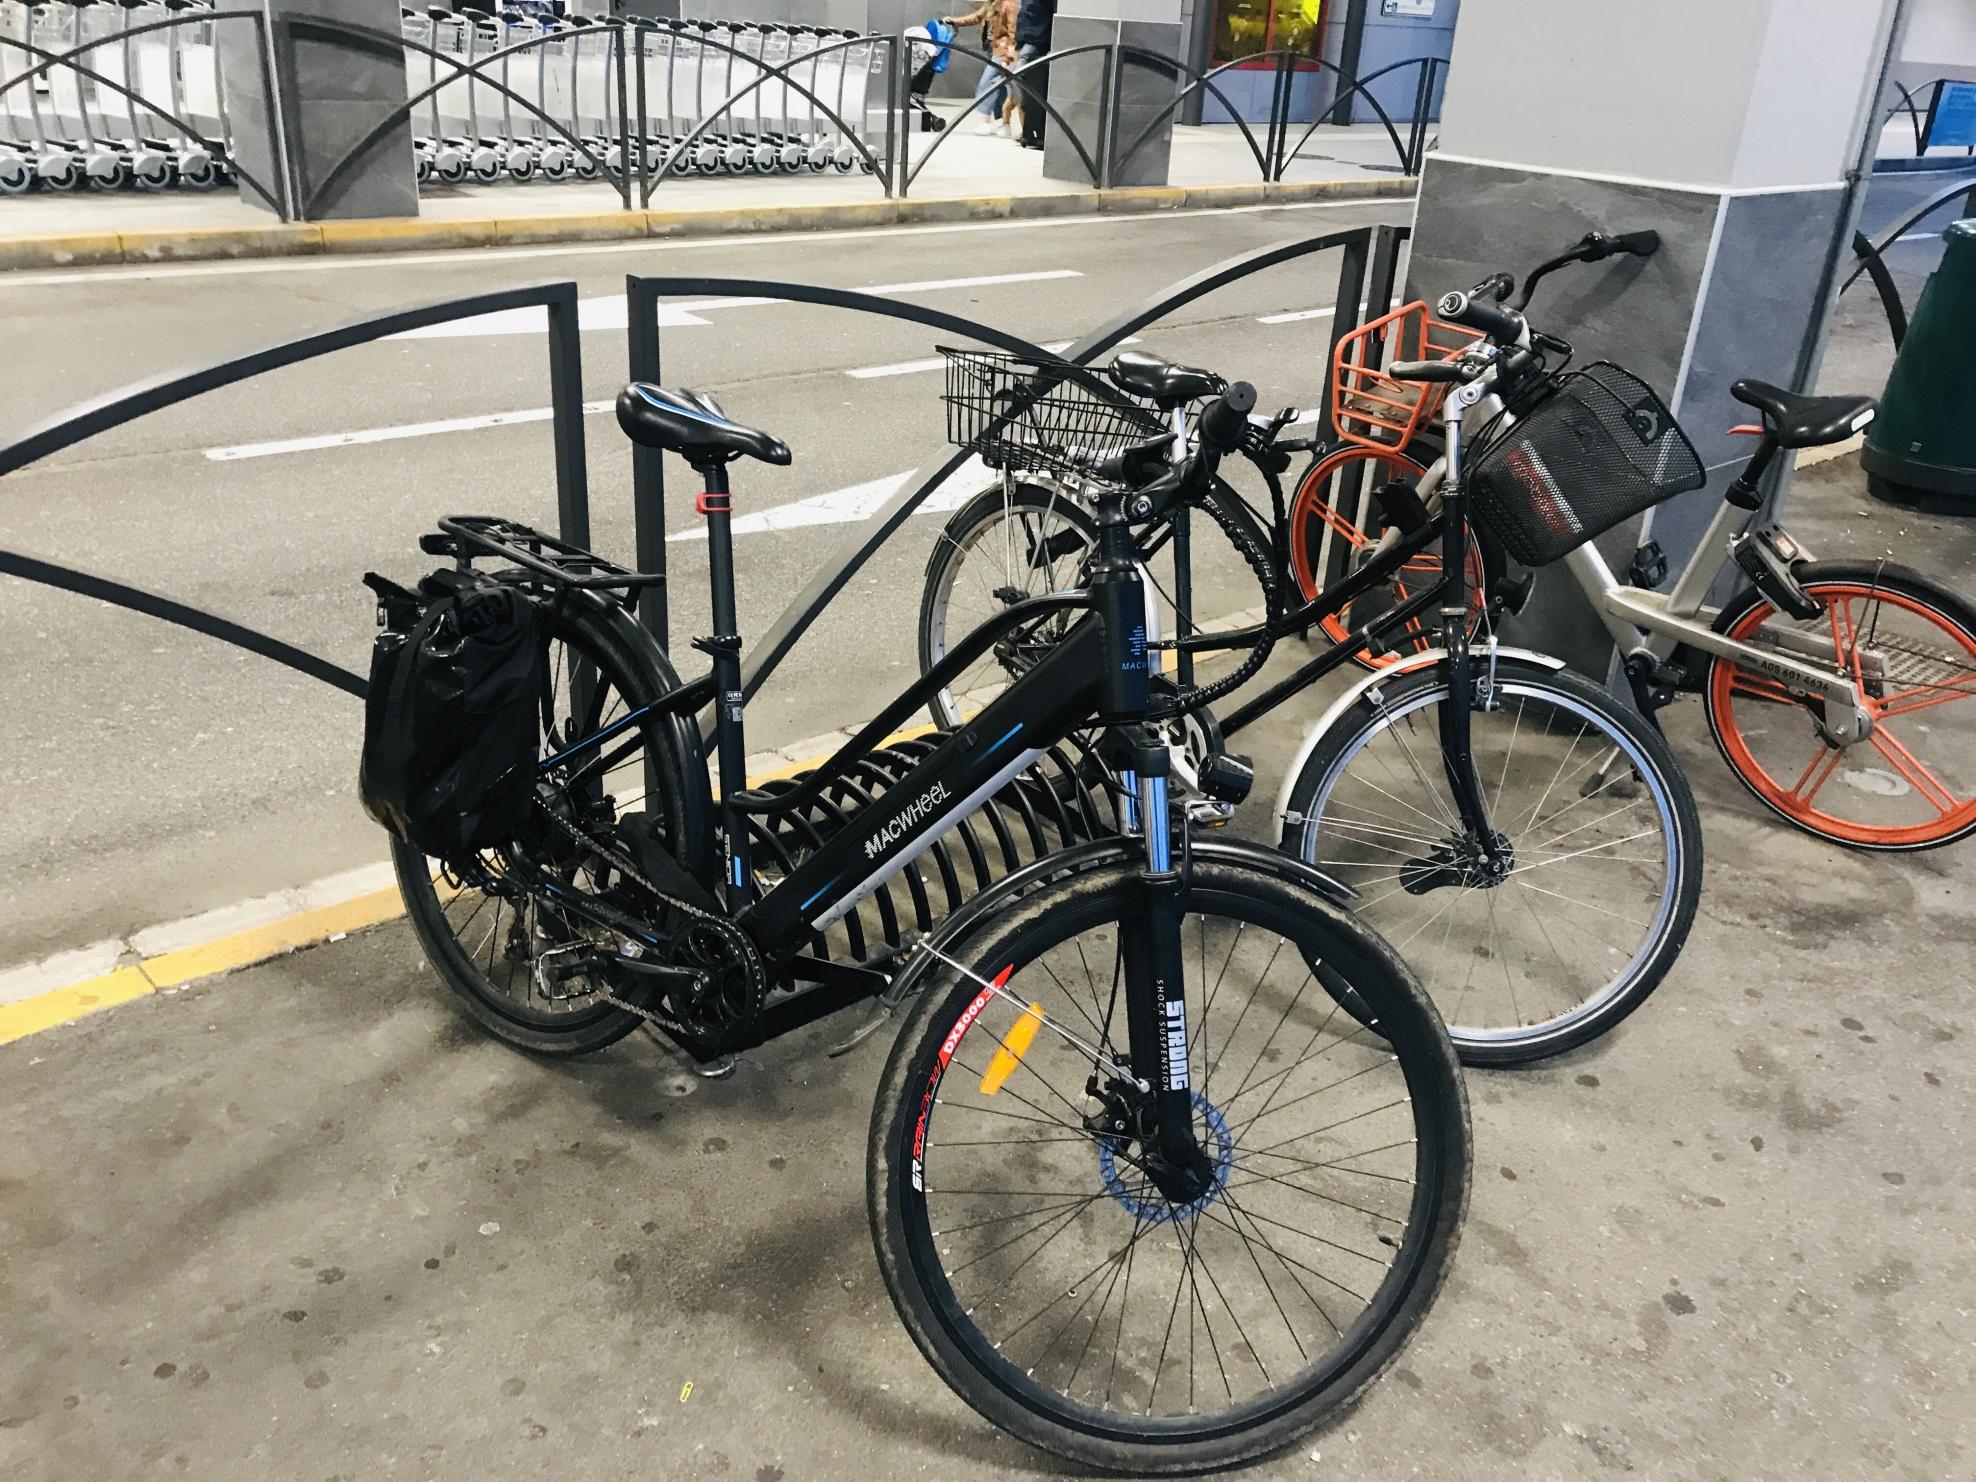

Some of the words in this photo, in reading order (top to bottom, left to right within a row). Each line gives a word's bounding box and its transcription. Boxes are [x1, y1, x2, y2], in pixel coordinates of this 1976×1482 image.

[943, 996, 985, 1055] DX3000
[1157, 979, 1165, 1016] SHOCK
[1158, 1021, 1169, 1092] SUSPENSION
[1166, 1000, 1189, 1090] STRONG
